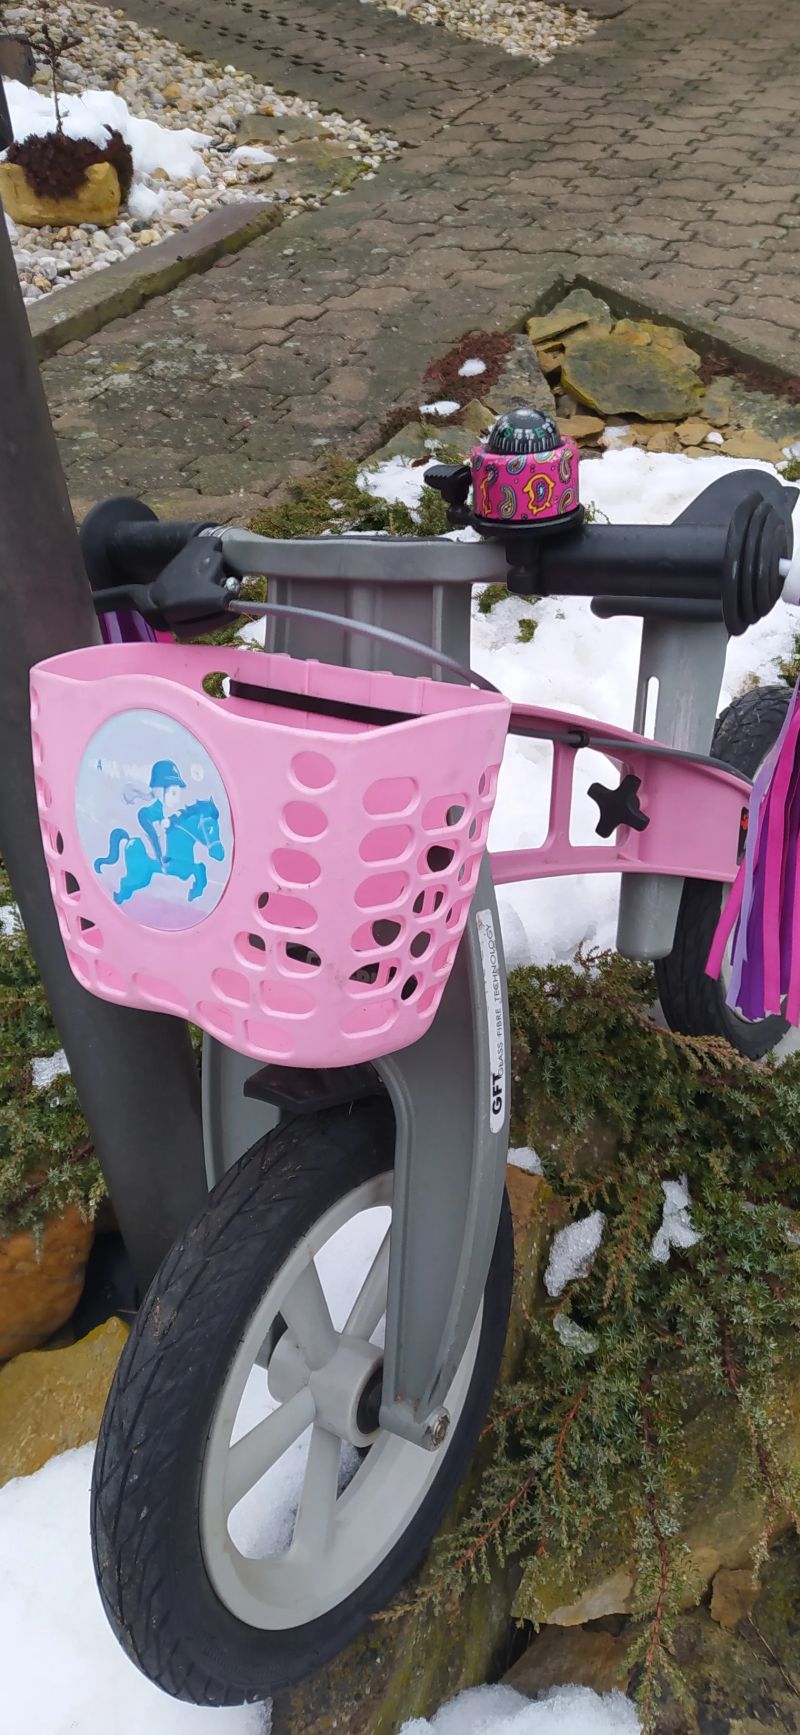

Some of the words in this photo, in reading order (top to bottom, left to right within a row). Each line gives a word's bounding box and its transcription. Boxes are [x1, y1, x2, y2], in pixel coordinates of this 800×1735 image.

[486, 924, 501, 1002] TECHNOLOGY
[495, 1008, 503, 1036] FIBRE
[492, 1073, 502, 1115] GFT
